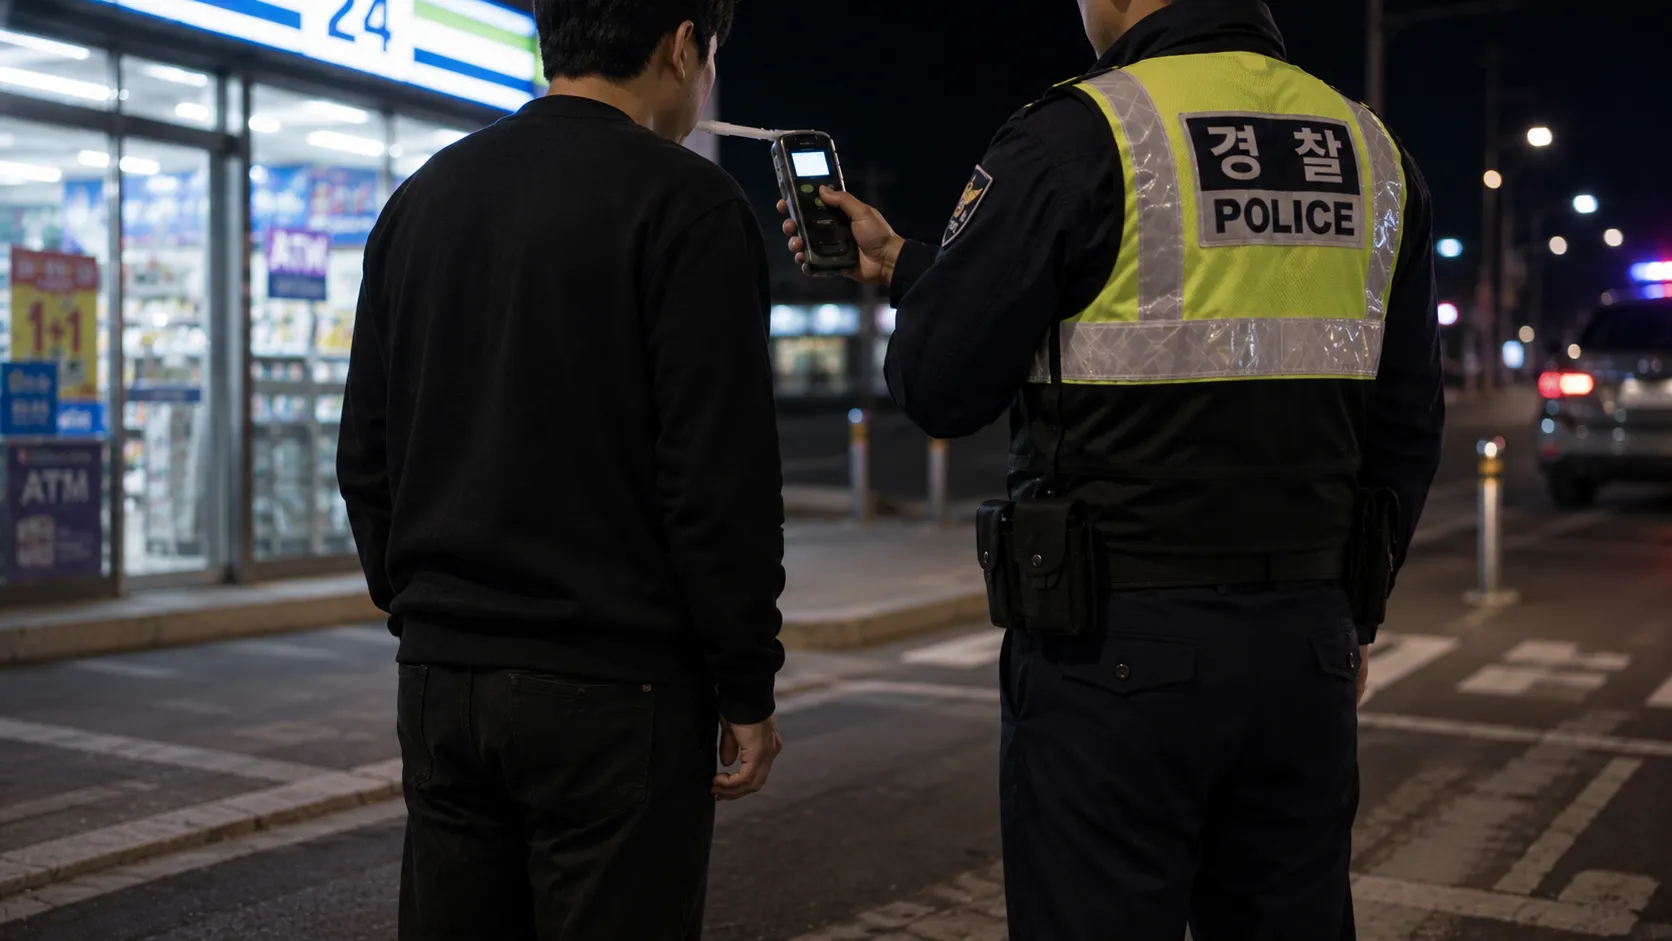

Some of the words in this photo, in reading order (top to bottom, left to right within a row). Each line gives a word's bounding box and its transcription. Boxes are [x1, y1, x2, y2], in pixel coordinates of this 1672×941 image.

[328, 0, 391, 51] 24
[1214, 197, 1354, 236] POLICE
[268, 226, 327, 270] ATM
[28, 300, 82, 353] 1+1
[21, 467, 90, 507] ATM
